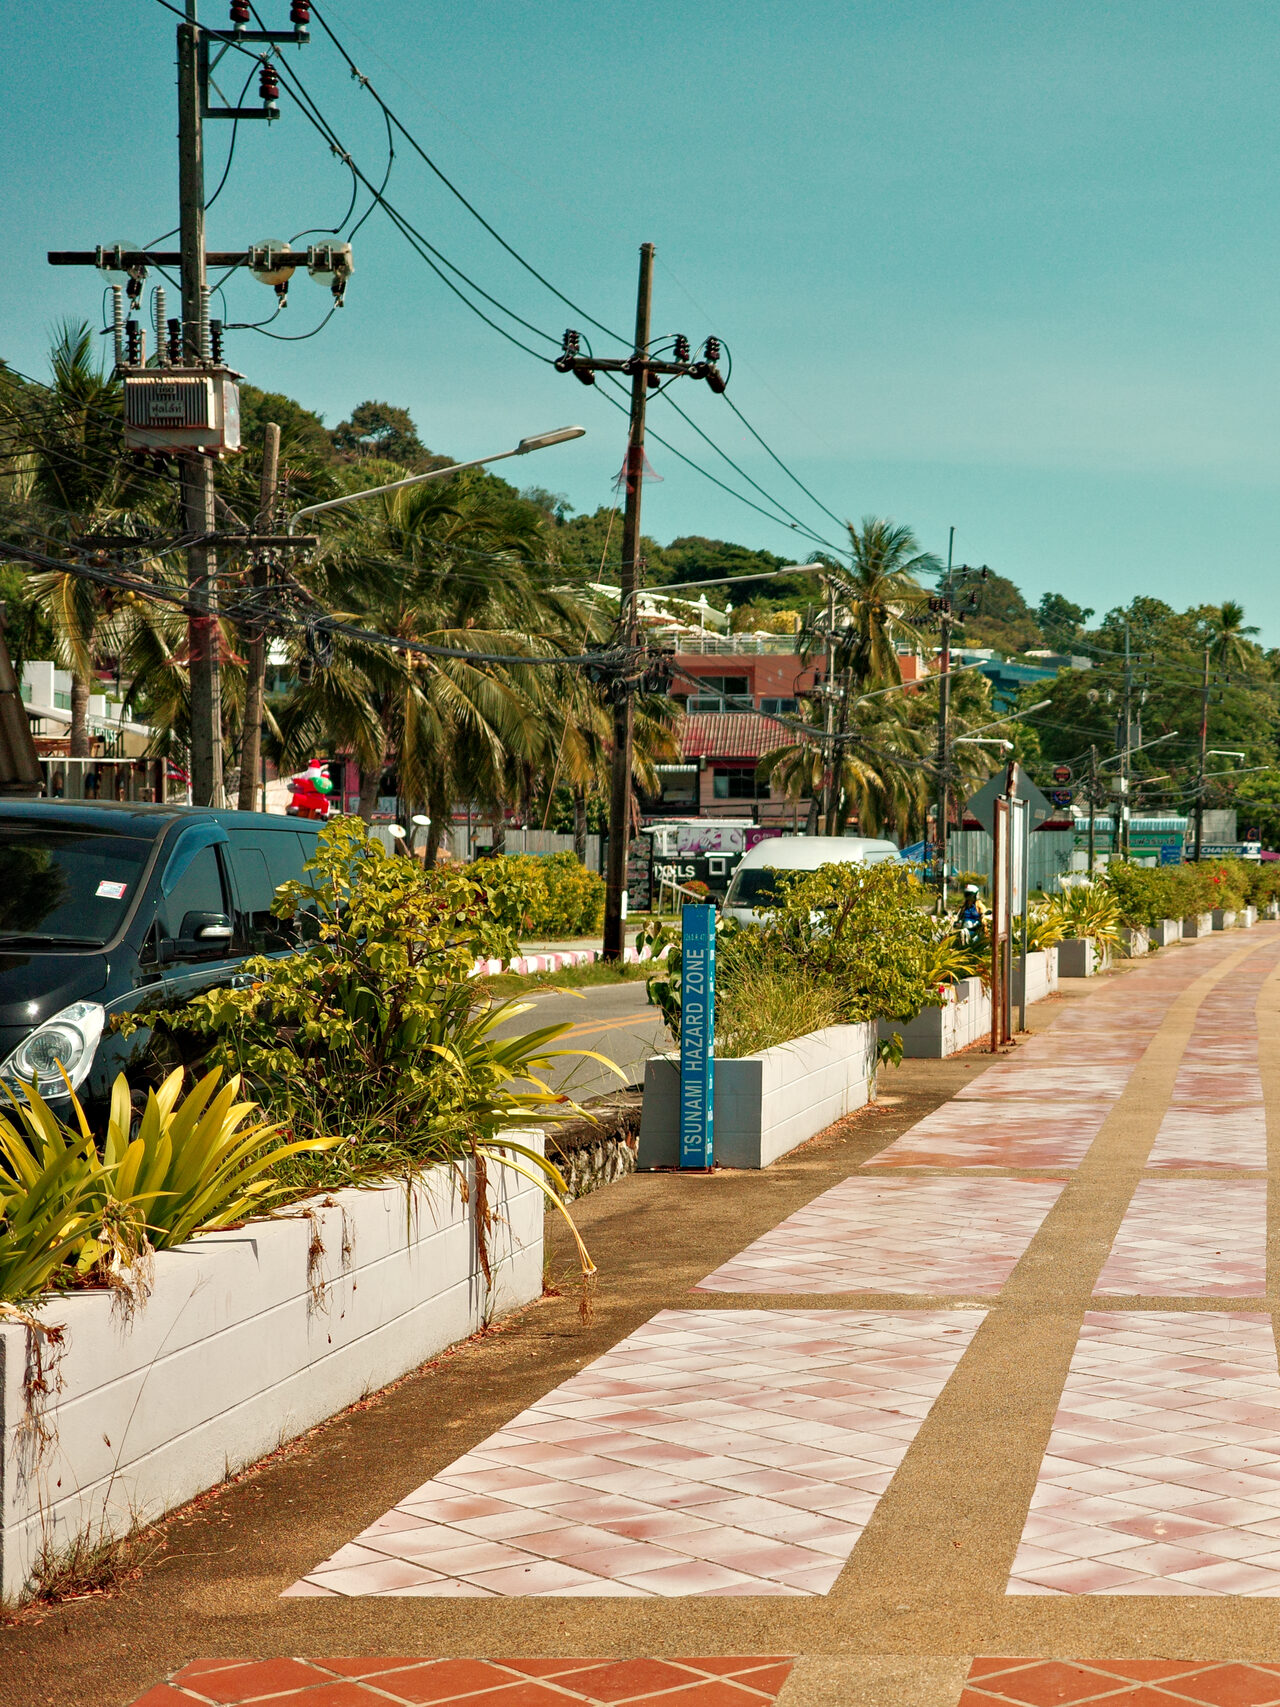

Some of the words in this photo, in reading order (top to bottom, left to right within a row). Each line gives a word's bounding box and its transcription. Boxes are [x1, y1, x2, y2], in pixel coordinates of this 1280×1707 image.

[1187, 846, 1242, 854] ECHANGE
[686, 949, 704, 994] ZONE
[685, 1003, 703, 1071] HAZARD
[684, 1080, 702, 1155] TSUNAMI
